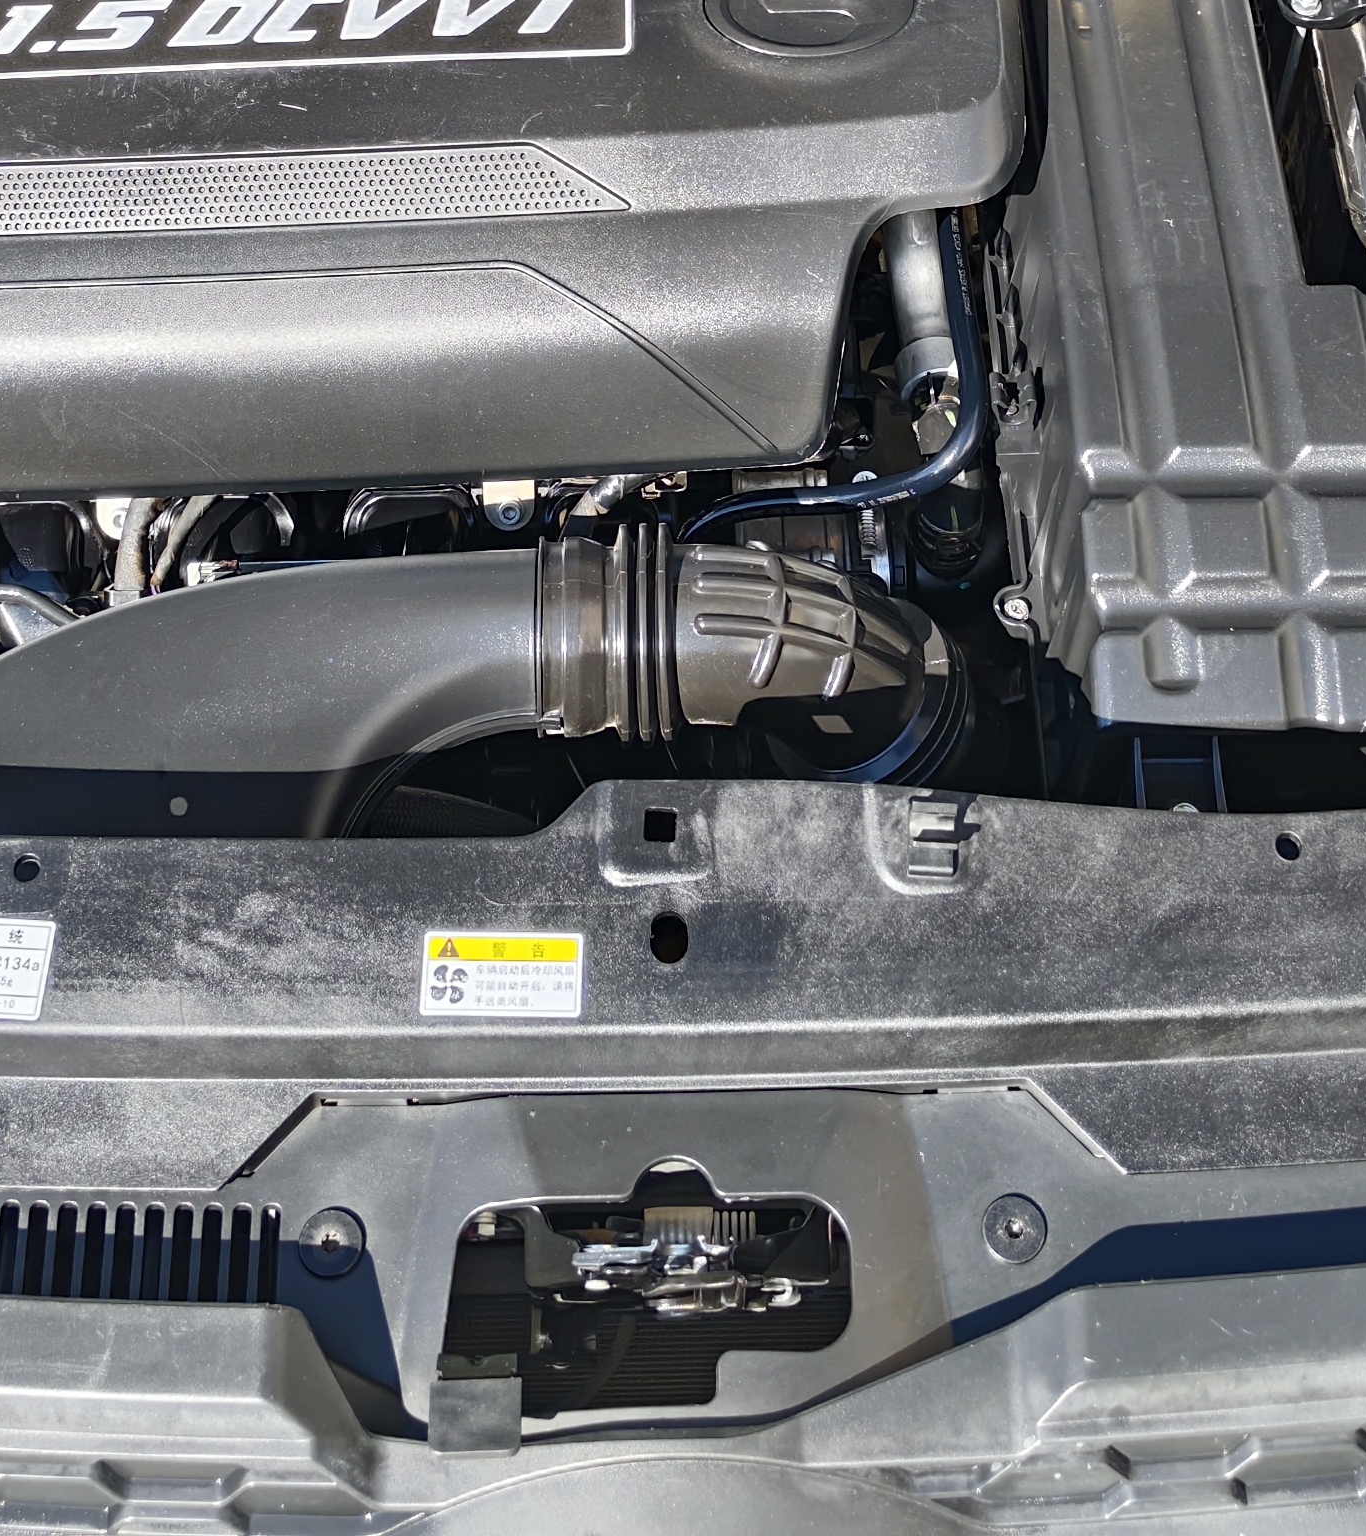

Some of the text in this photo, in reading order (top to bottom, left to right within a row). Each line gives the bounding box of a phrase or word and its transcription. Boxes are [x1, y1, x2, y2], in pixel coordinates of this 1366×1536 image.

[493, 941, 546, 958] 警告
[476, 964, 575, 976] 车辆启动后冷却风扇
